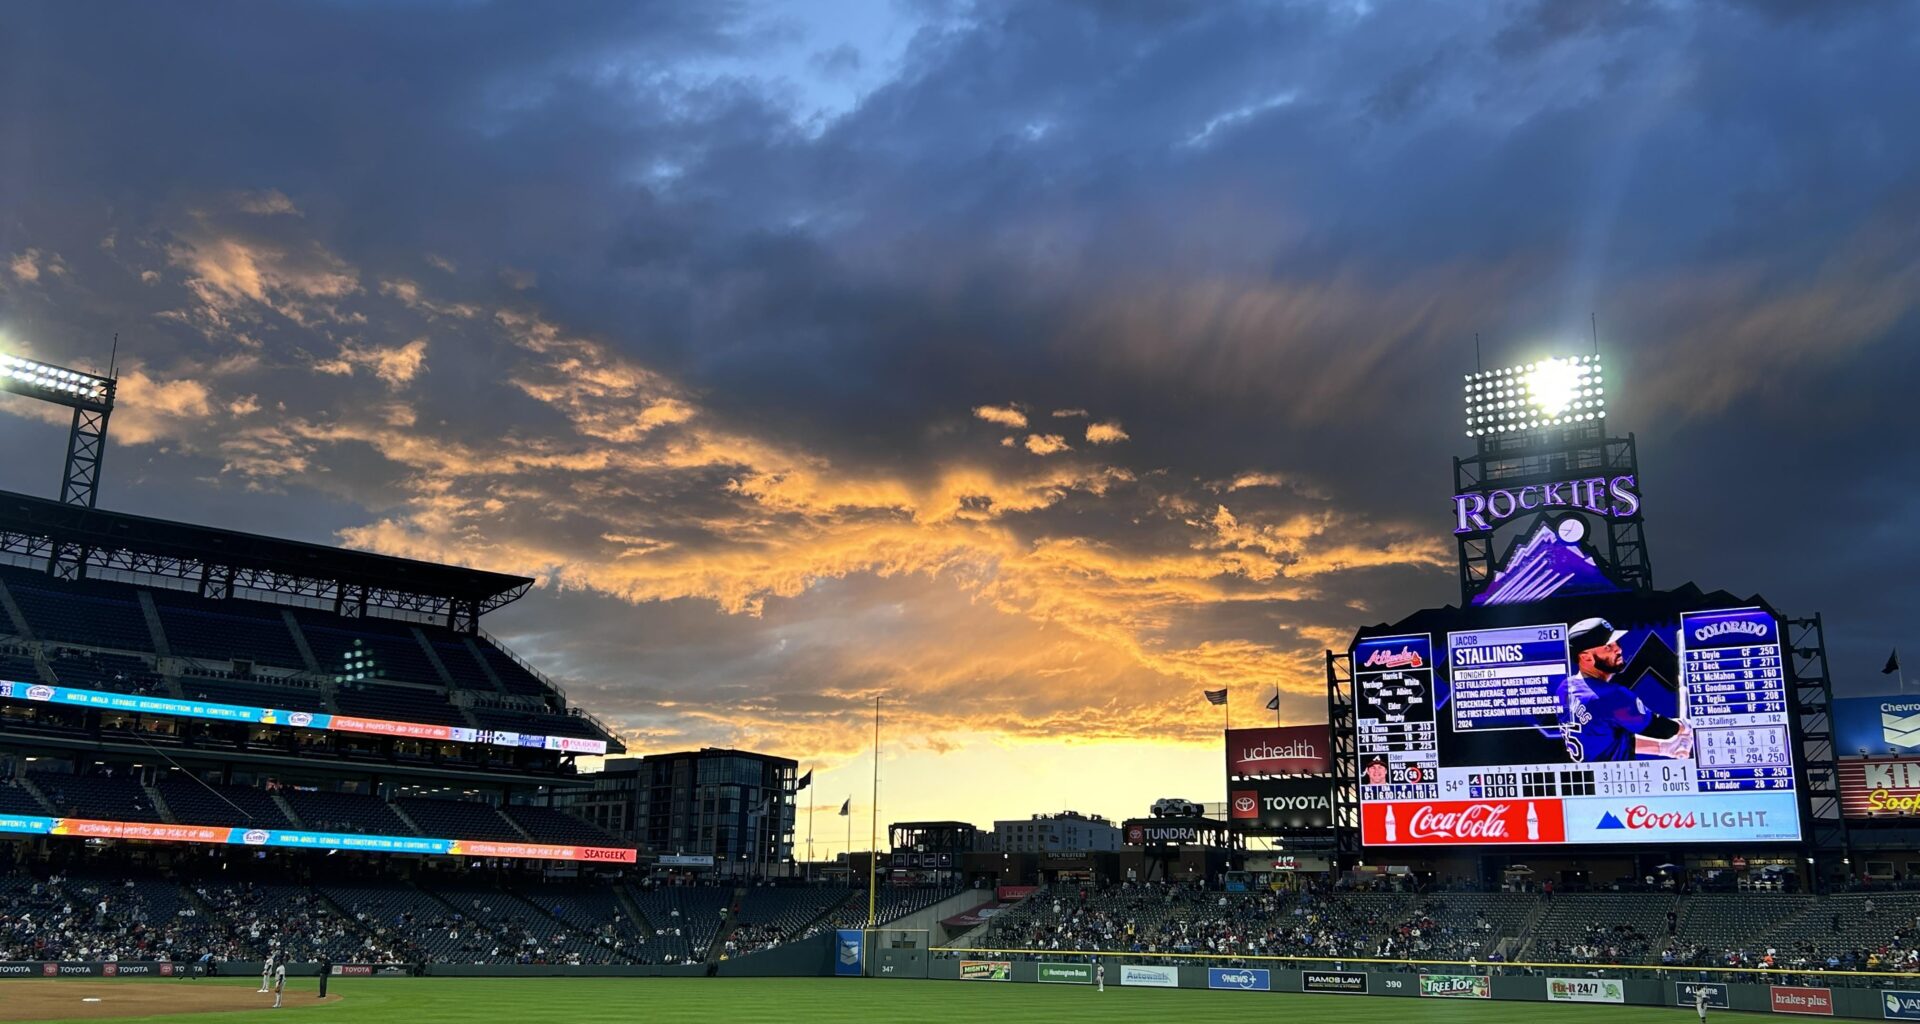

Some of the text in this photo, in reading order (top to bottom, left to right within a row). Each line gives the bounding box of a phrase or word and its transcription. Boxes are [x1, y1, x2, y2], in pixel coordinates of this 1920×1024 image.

[1451, 475, 1639, 533] ROCKIES
[1695, 621, 1767, 641] COLORADO
[1456, 630, 1557, 646] JACOB 25 C
[1456, 645, 1523, 664] STALLINGS
[1694, 652, 1698, 660] 9
[1702, 652, 1720, 660] Doyle
[1759, 647, 1774, 655] .250
[1703, 662, 1719, 670] Beck
[1760, 658, 1774, 666] .271
[1460, 671, 1485, 679] TONIGHT
[1704, 673, 1735, 681] McMahon
[1761, 670, 1776, 678] .160
[1502, 679, 1523, 687] CAREER
[1705, 684, 1735, 692] Goodman
[1456, 691, 1479, 699] BATTING
[1520, 687, 1547, 695] SLUGGING
[1537, 696, 1552, 704] RUNS
[1706, 695, 1725, 704] Toglia
[1532, 706, 1556, 714] ROCKIES
[1707, 706, 1730, 714] Moniak
[1765, 703, 1780, 711] .214
[1458, 720, 1472, 728] 2024
[1708, 735, 1775, 746] 8 44 3 0
[1243, 739, 1315, 760] uchealth
[1710, 755, 1735, 764] 0 5
[1394, 770, 1434, 781] 23 33
[1603, 771, 1648, 780] 3 7 1 4
[1713, 770, 1730, 779] Trejo
[1772, 768, 1787, 776] .250
[1487, 775, 1528, 784] 0 0 2 1
[1487, 787, 1514, 796] 3 0 0
[1605, 783, 1649, 793] 3 3 0 2
[1663, 782, 1689, 791] 0 OUTS
[1263, 796, 1330, 811] TOYOTA
[1409, 804, 1508, 837] Coca-Cola
[1625, 805, 1767, 829] Coors LIGHT
[1144, 828, 1196, 839] TUNDRA
[584, 849, 626, 860] SEATGEEK
[964, 964, 988, 973] MIGHTY
[1386, 980, 1402, 988] 390
[1426, 978, 1473, 992] TREE TOP
[1577, 983, 1598, 993] 24/7
[1775, 993, 1827, 1007] brakes plus
